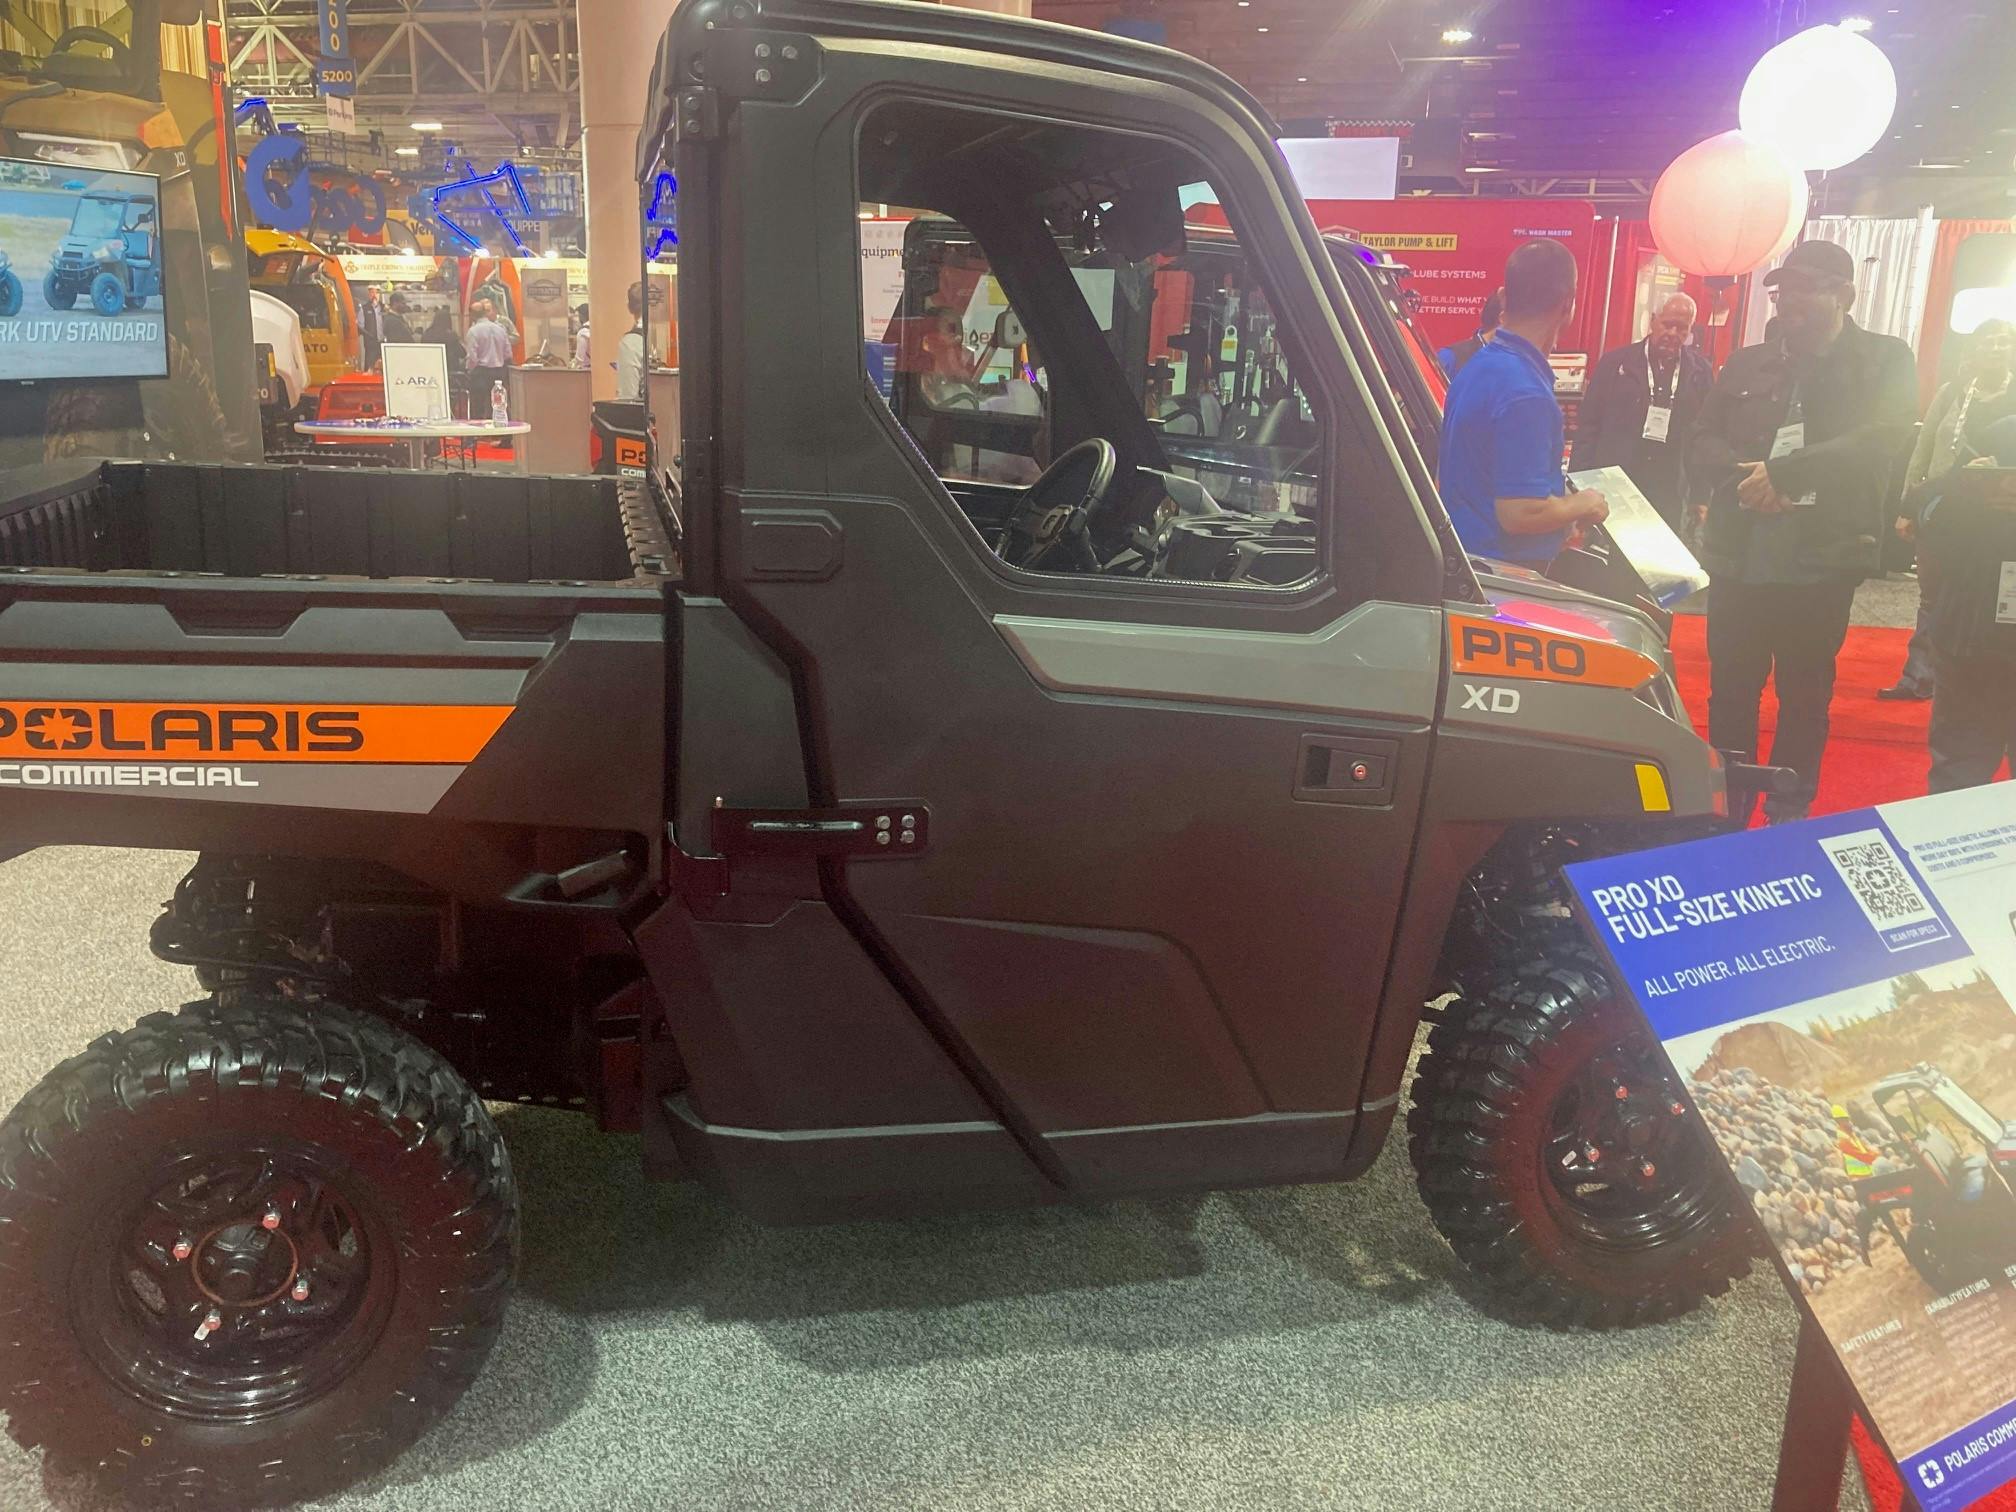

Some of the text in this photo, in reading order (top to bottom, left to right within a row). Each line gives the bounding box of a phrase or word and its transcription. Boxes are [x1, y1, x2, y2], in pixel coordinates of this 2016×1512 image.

[321, 70, 353, 83] 5200
[1363, 236, 1396, 248] TAYLOR
[1399, 236, 1423, 248] PUMP
[1425, 237, 1433, 248] &
[1435, 237, 1454, 248] LIFT
[1548, 229, 1572, 237] MASTER
[1413, 269, 1487, 280] LUBE SYSTEMS
[1430, 295, 1456, 304] BUILD
[1457, 296, 1482, 304] WHAT
[1448, 306, 1476, 315] SERVE
[26, 321, 63, 342] UTV
[66, 321, 158, 343] STANDARD
[1462, 626, 1586, 677] PRO
[1460, 684, 1521, 714] XD
[0, 764, 259, 787] COMMERCIAL
[1591, 874, 1685, 916] PRO XD
[1606, 873, 1822, 944] FULL-SIZE KINETIC
[1644, 935, 1836, 999] ALL POWER. ALL ELECTRIC.
[1943, 1436, 1990, 1472] POLARIS
